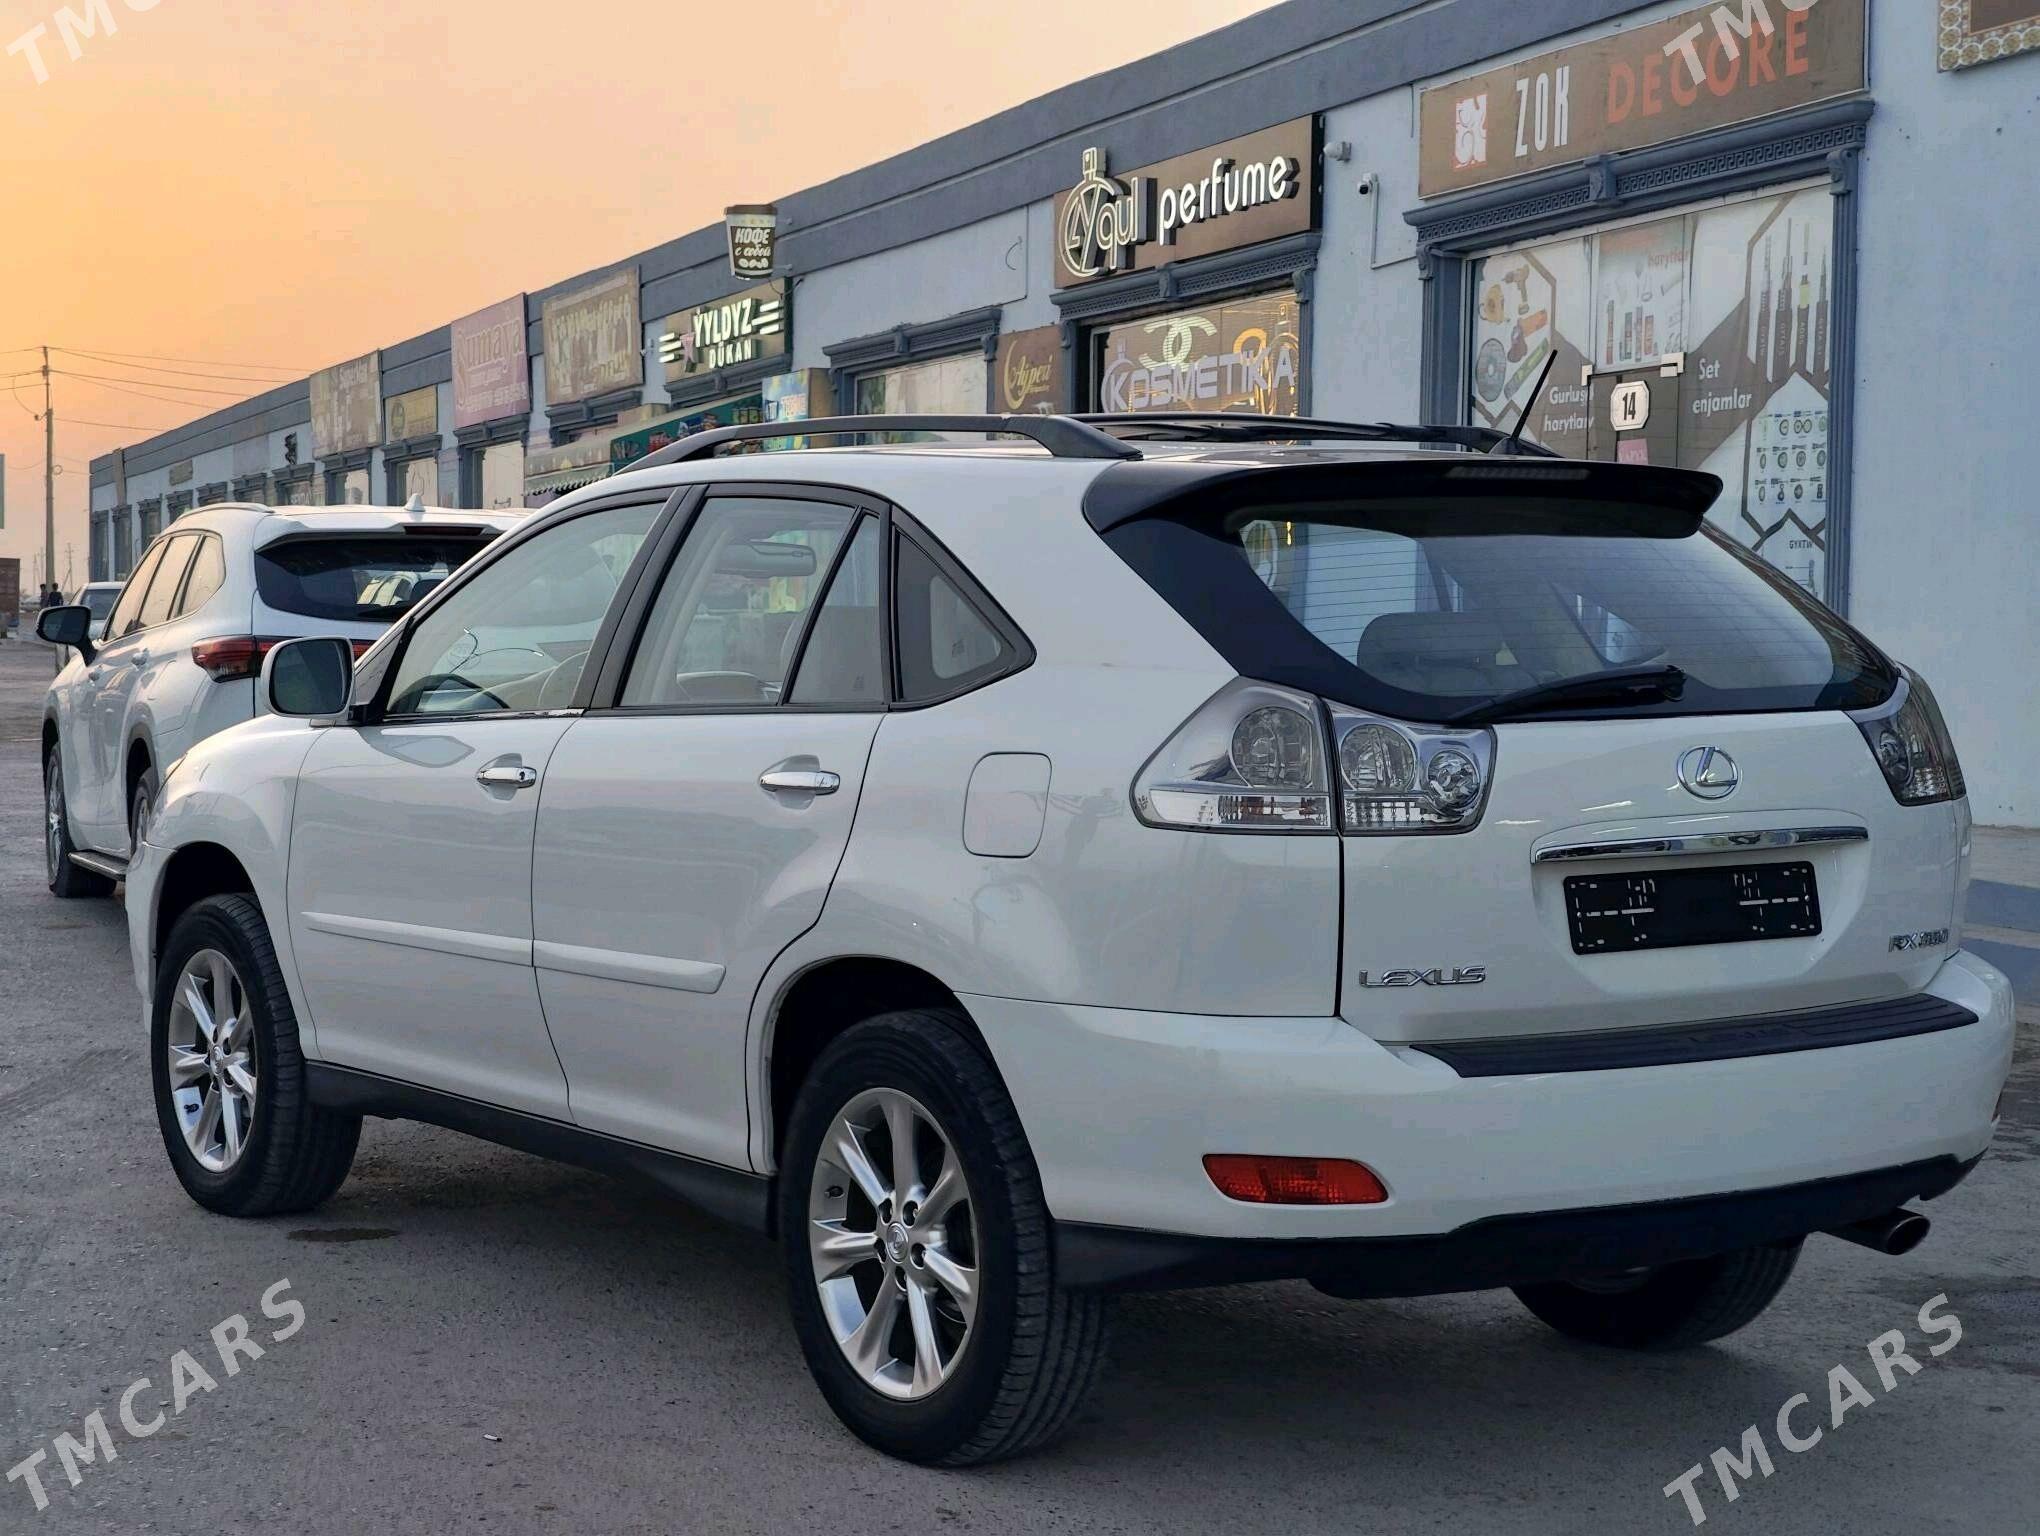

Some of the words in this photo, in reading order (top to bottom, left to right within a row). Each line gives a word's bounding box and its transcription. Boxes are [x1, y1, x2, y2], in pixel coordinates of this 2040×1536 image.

[1515, 66, 1570, 157] ZOK
[1606, 9, 1810, 124] DECORE
[1159, 156, 1288, 246] perfume
[735, 228, 771, 244] КОФЕ
[1110, 347, 1295, 412] KOSMETIKA
[1699, 358, 1720, 380] Set
[1622, 391, 1637, 420] 14
[1692, 388, 1752, 417] enjamlar
[1359, 966, 1486, 988] LEXUS
